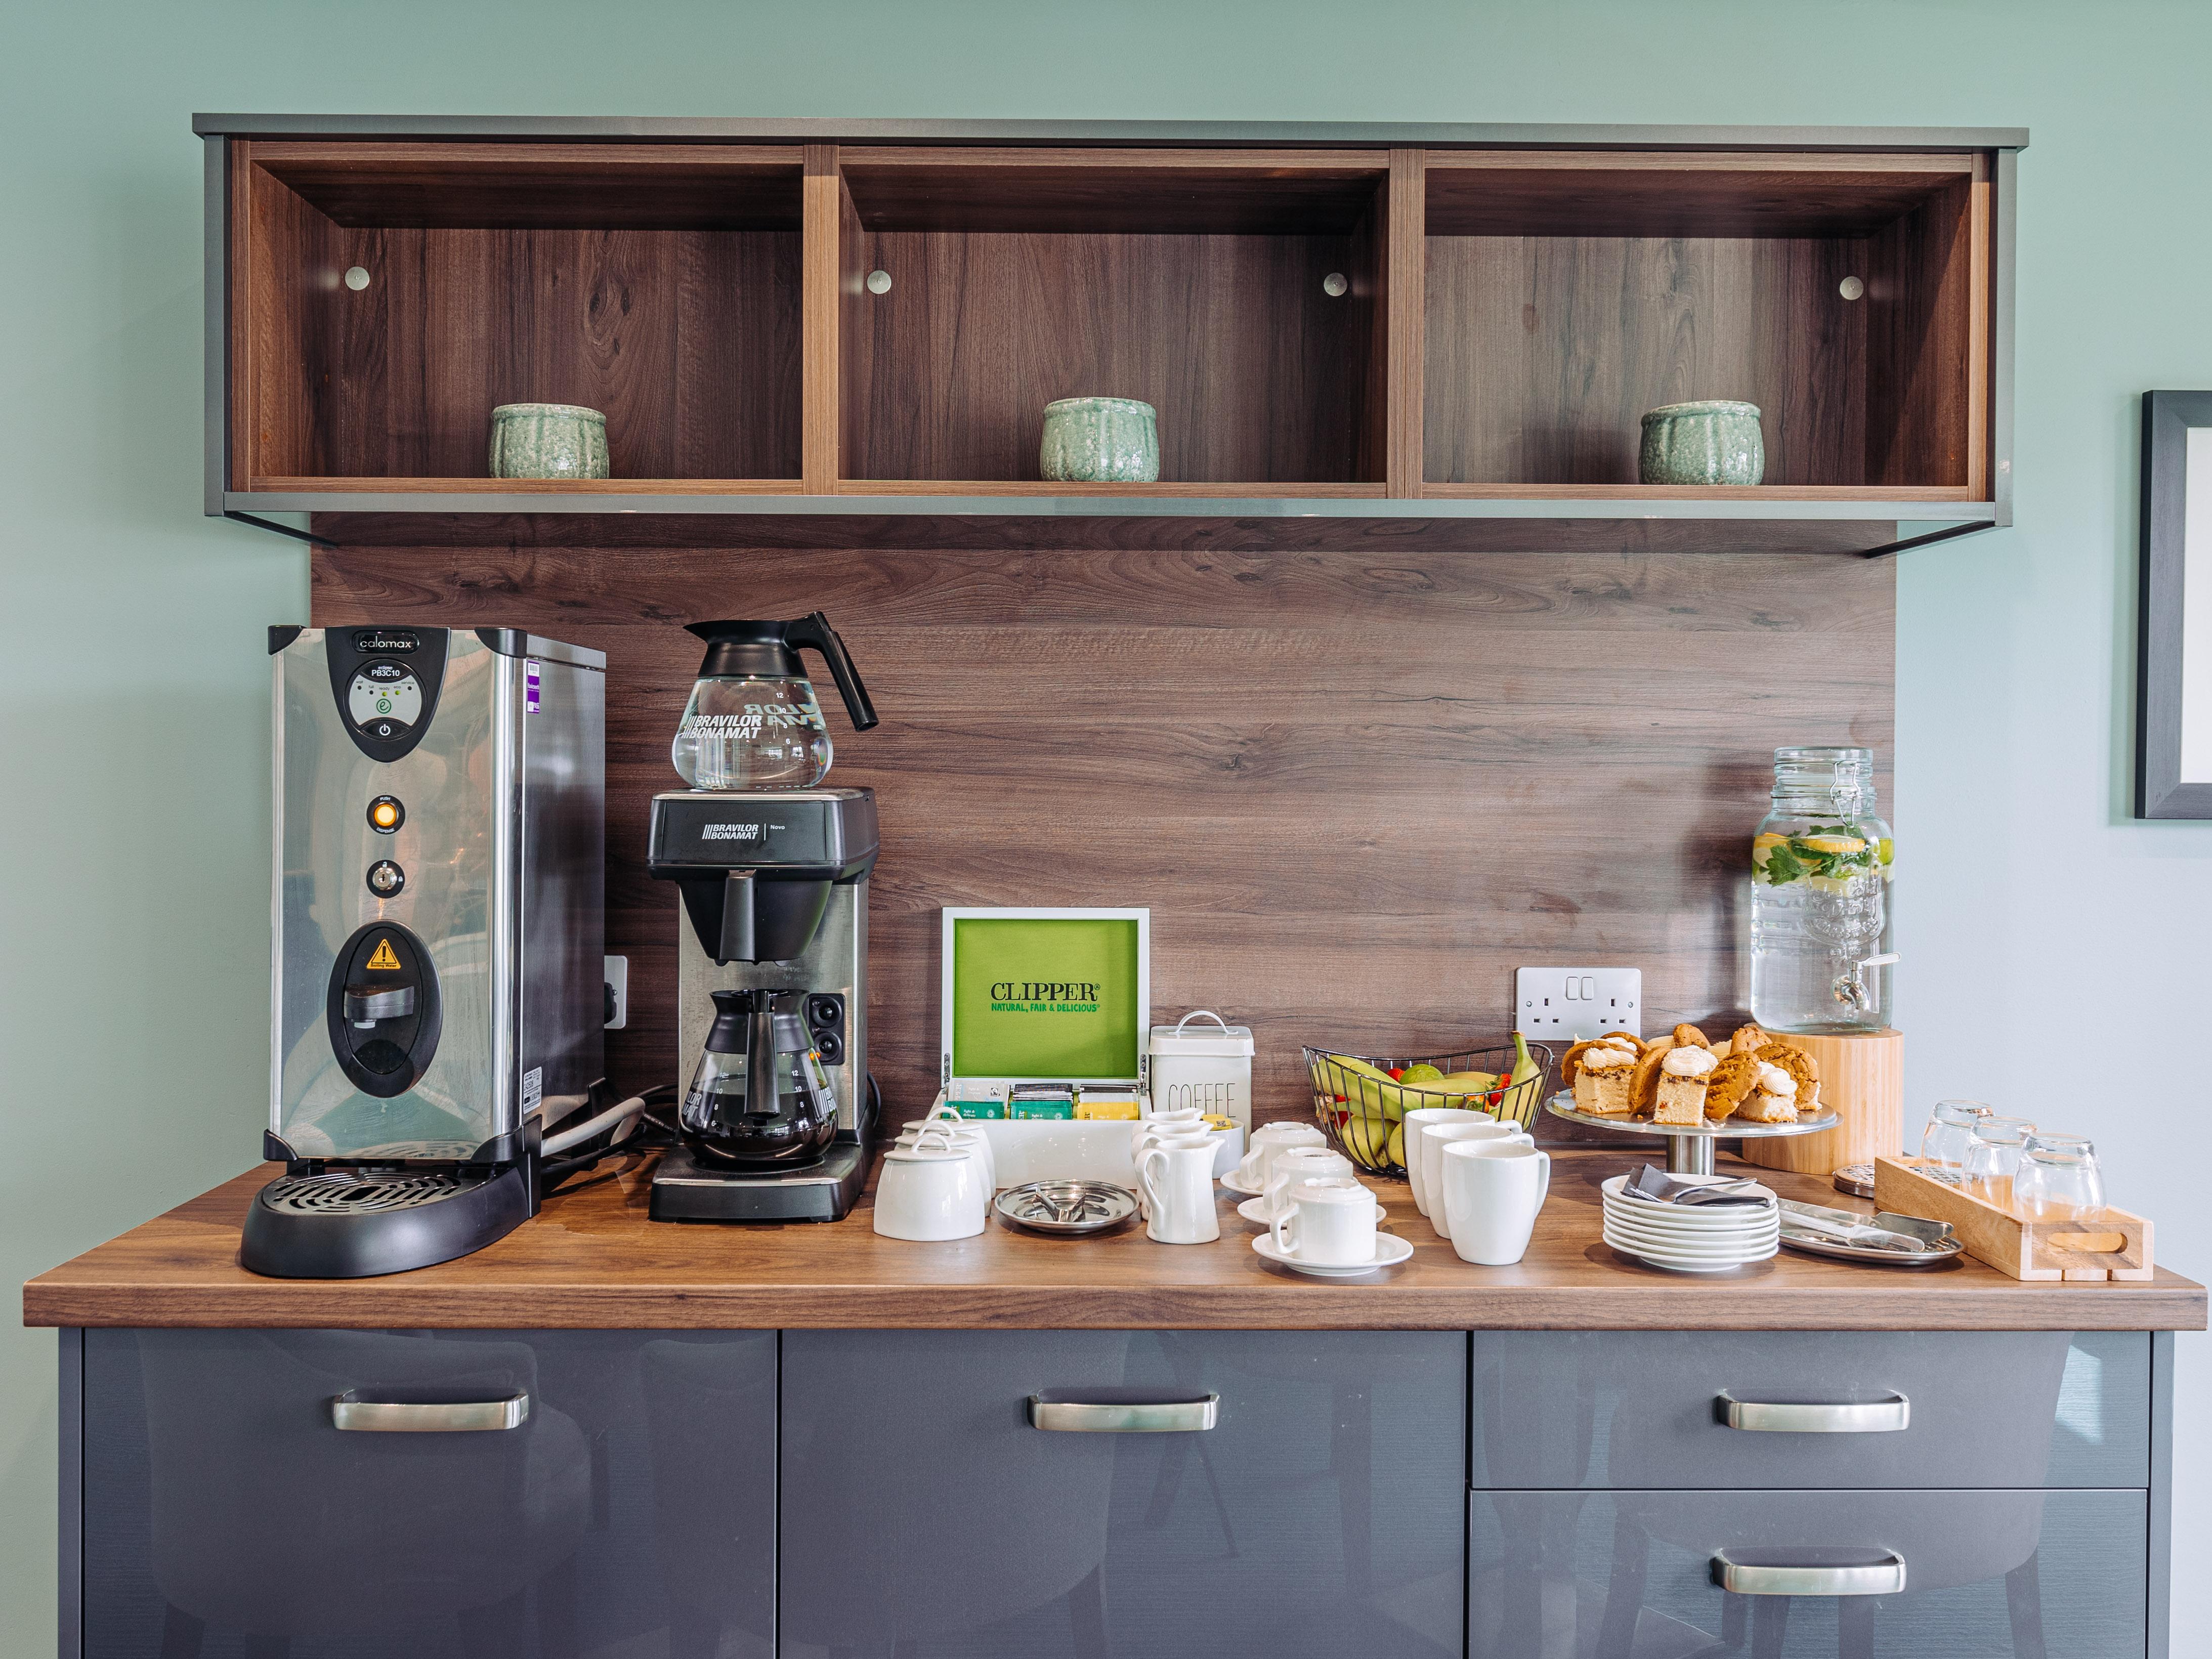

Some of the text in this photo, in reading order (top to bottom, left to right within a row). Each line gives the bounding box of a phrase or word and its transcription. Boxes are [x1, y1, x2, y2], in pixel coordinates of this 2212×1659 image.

[360, 635, 411, 648] calomax
[695, 714, 762, 727] BRAVILOR
[689, 727, 761, 739] BONAMAT
[991, 1003, 1029, 1012] NATURAL,
[1030, 1003, 1046, 1012] FAIR
[1049, 1004, 1055, 1012] &
[1168, 1083, 1236, 1118] COFFEE
